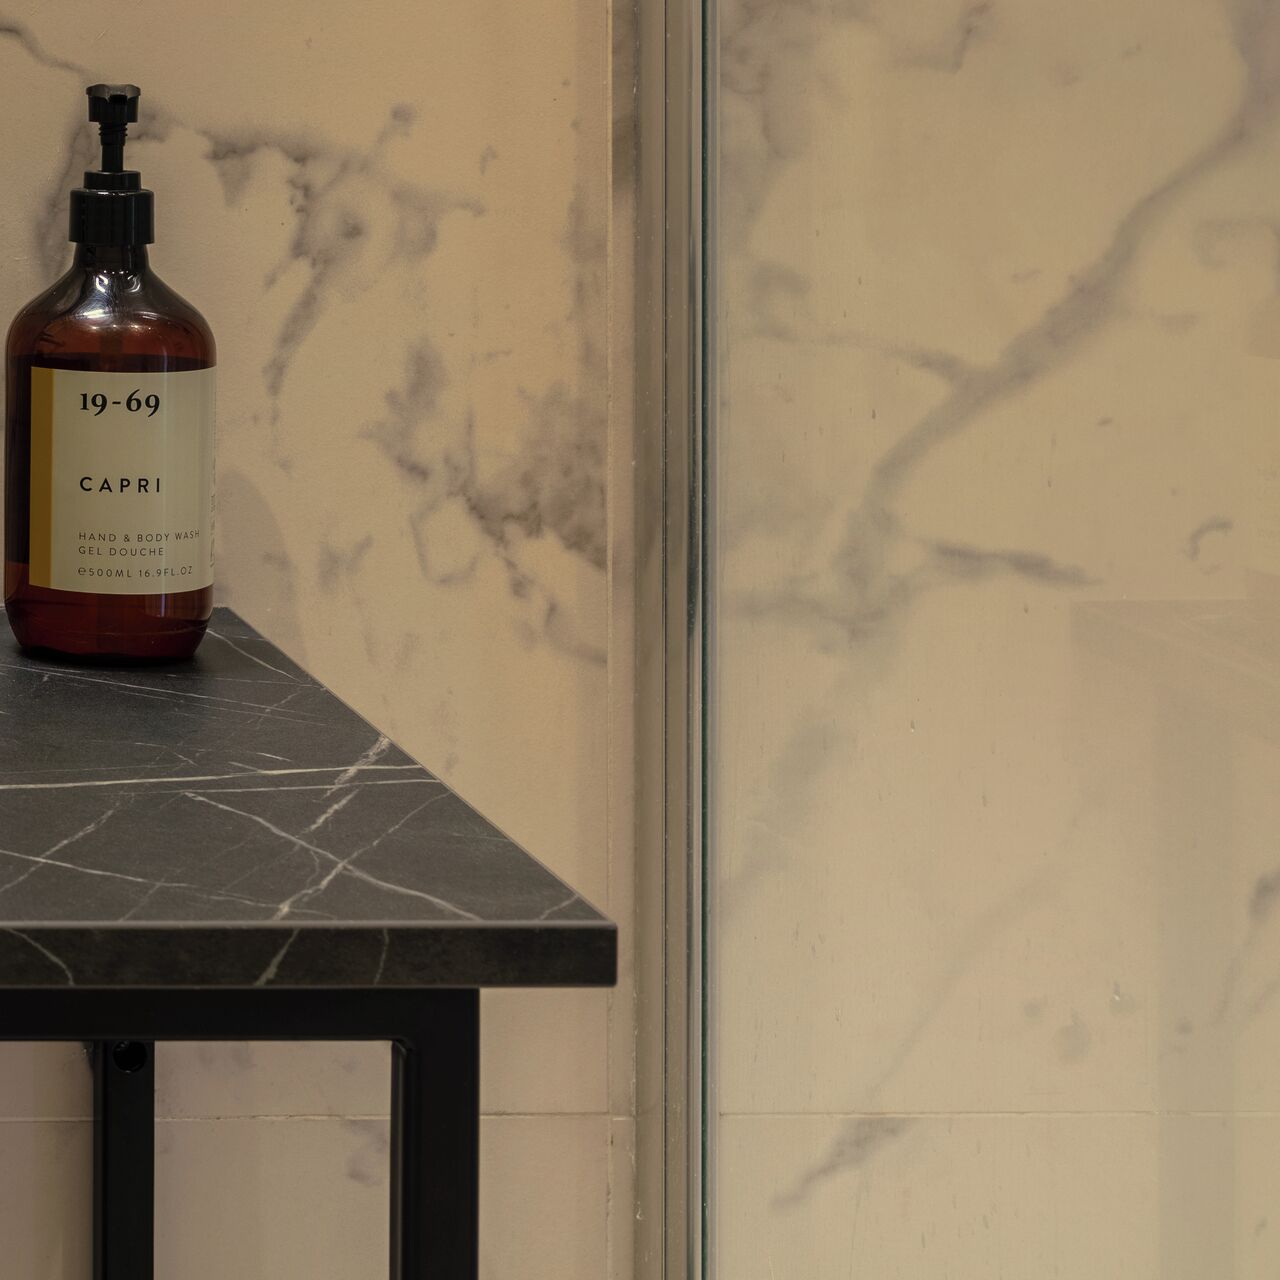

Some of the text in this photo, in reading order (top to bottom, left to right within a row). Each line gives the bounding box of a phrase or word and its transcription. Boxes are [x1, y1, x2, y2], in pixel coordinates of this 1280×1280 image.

[80, 388, 160, 417] 19-69
[79, 476, 160, 493] CAPRI
[78, 529, 200, 542] HAND & BODY WASH
[78, 546, 165, 556] GEL DOUCHE
